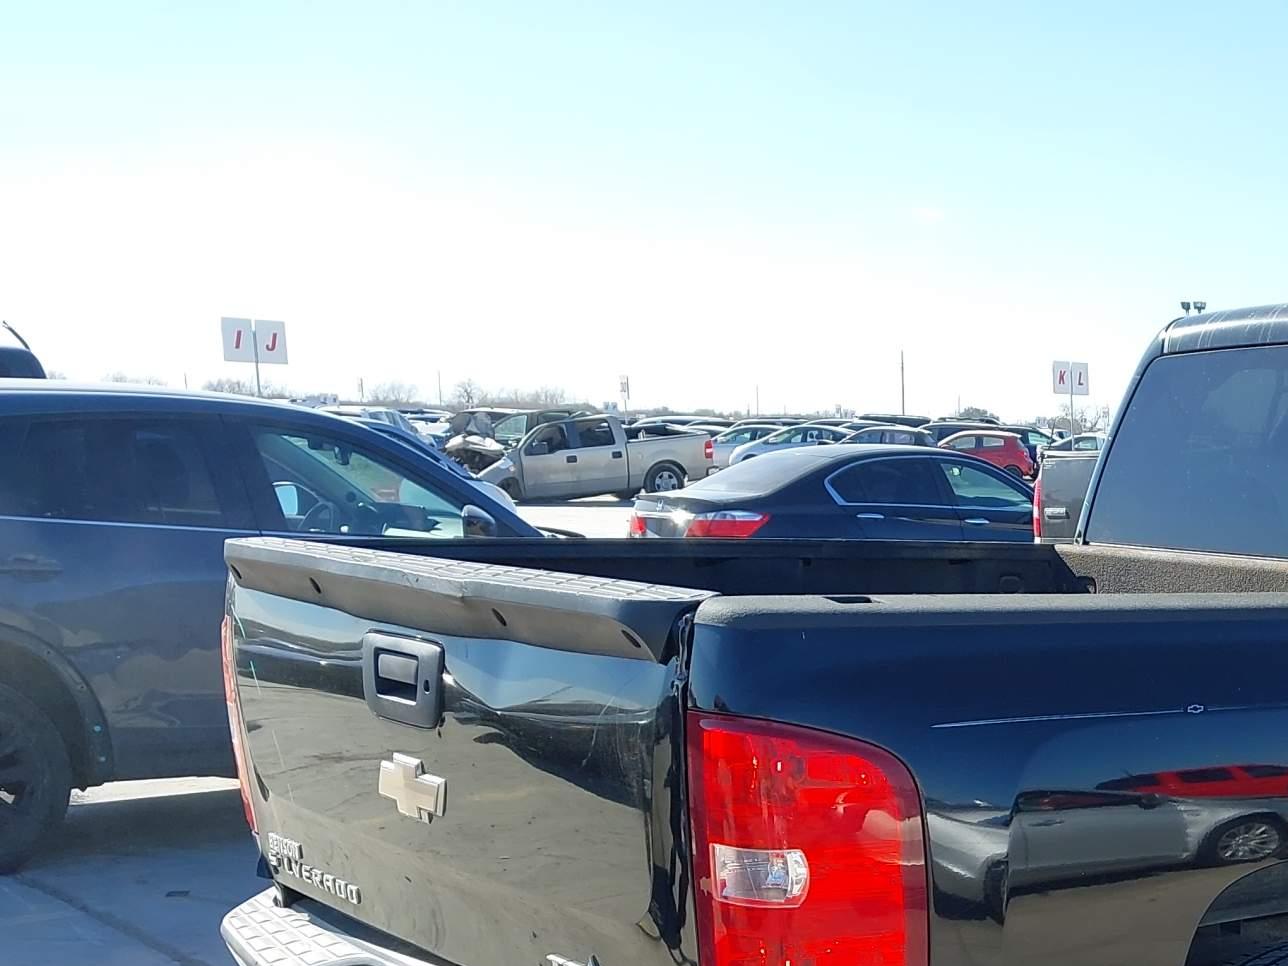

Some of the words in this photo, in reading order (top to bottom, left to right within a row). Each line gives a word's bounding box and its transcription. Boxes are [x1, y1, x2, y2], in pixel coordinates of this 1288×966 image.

[265, 332, 278, 352] J
[1058, 369, 1066, 385] K
[1077, 371, 1085, 386] L
[268, 851, 362, 905] SILVERADO
